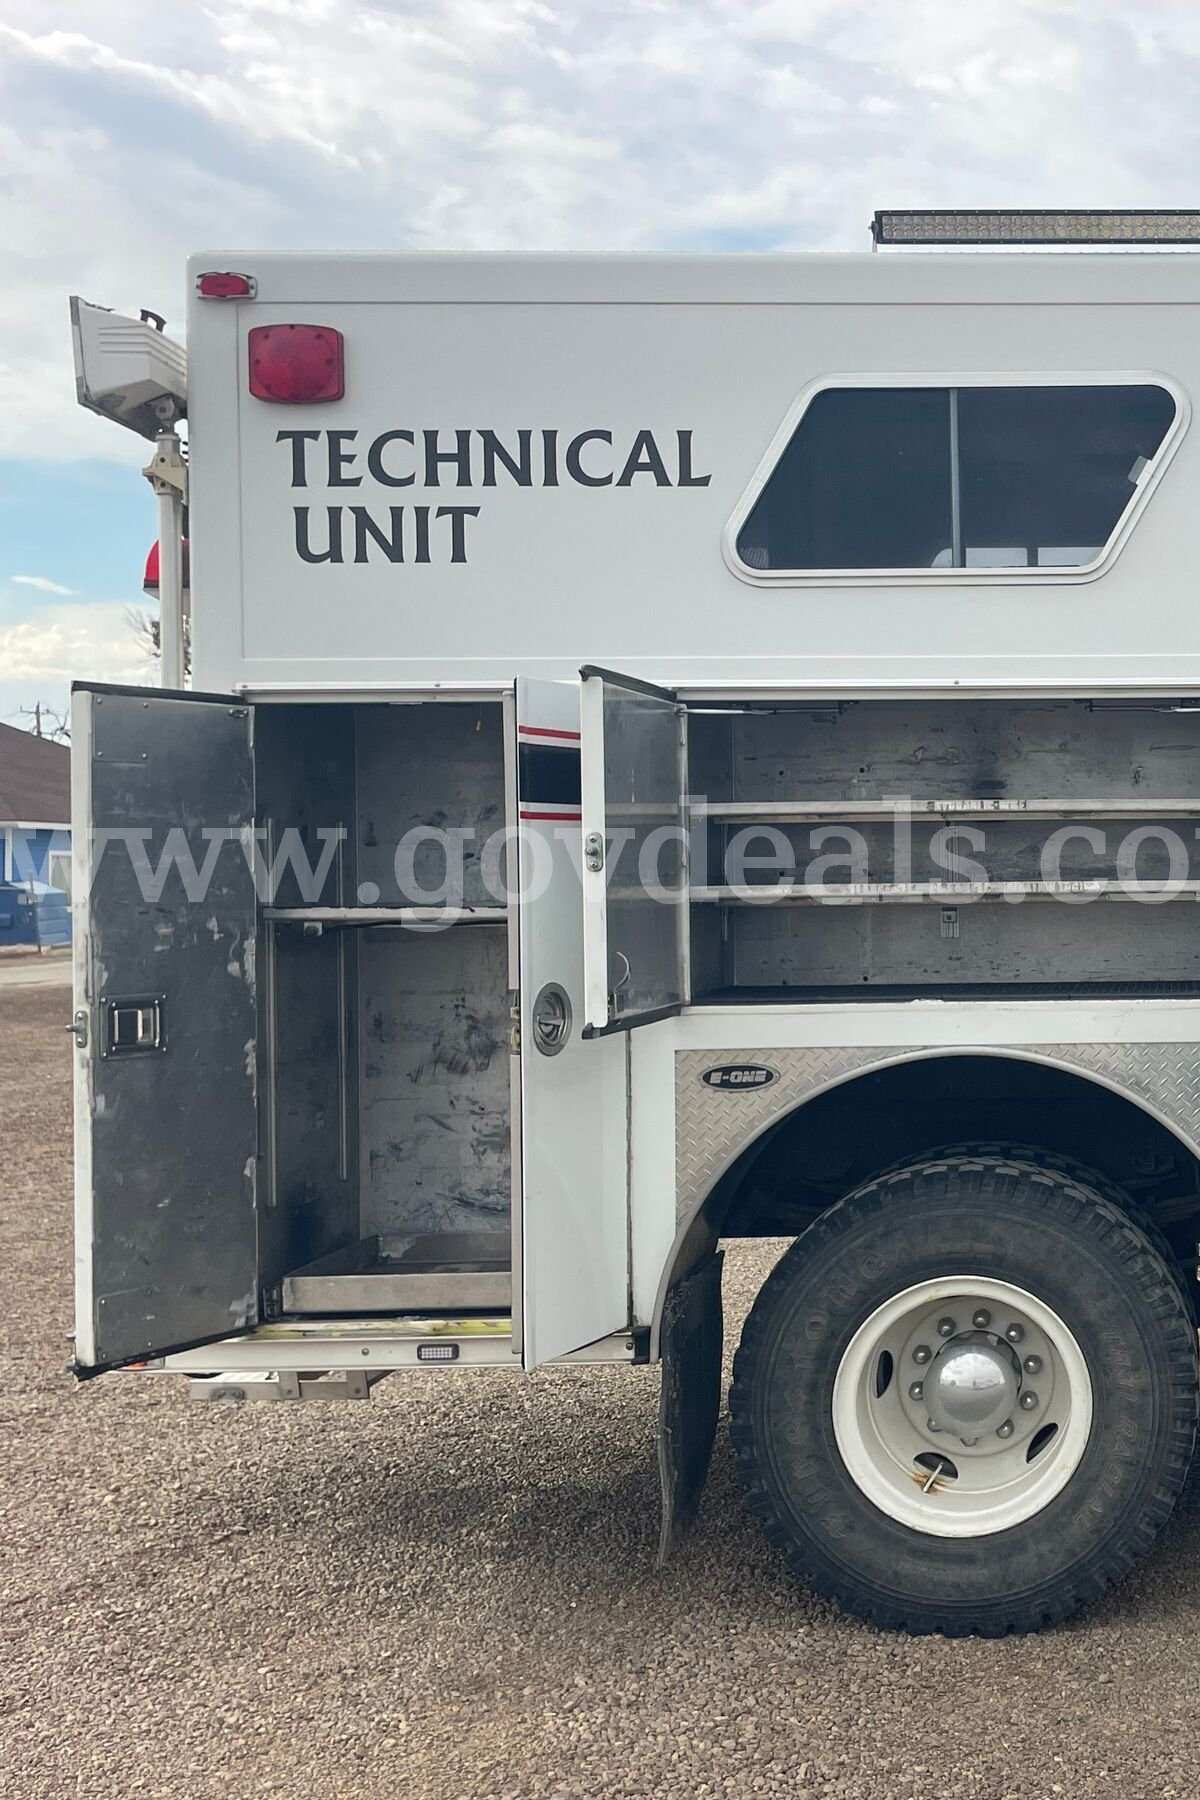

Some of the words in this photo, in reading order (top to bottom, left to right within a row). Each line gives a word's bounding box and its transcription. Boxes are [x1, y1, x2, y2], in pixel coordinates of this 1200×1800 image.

[276, 429, 712, 488] TECHNICAL
[293, 505, 481, 564] UNIT
[709, 1070, 767, 1084] E-ONE
